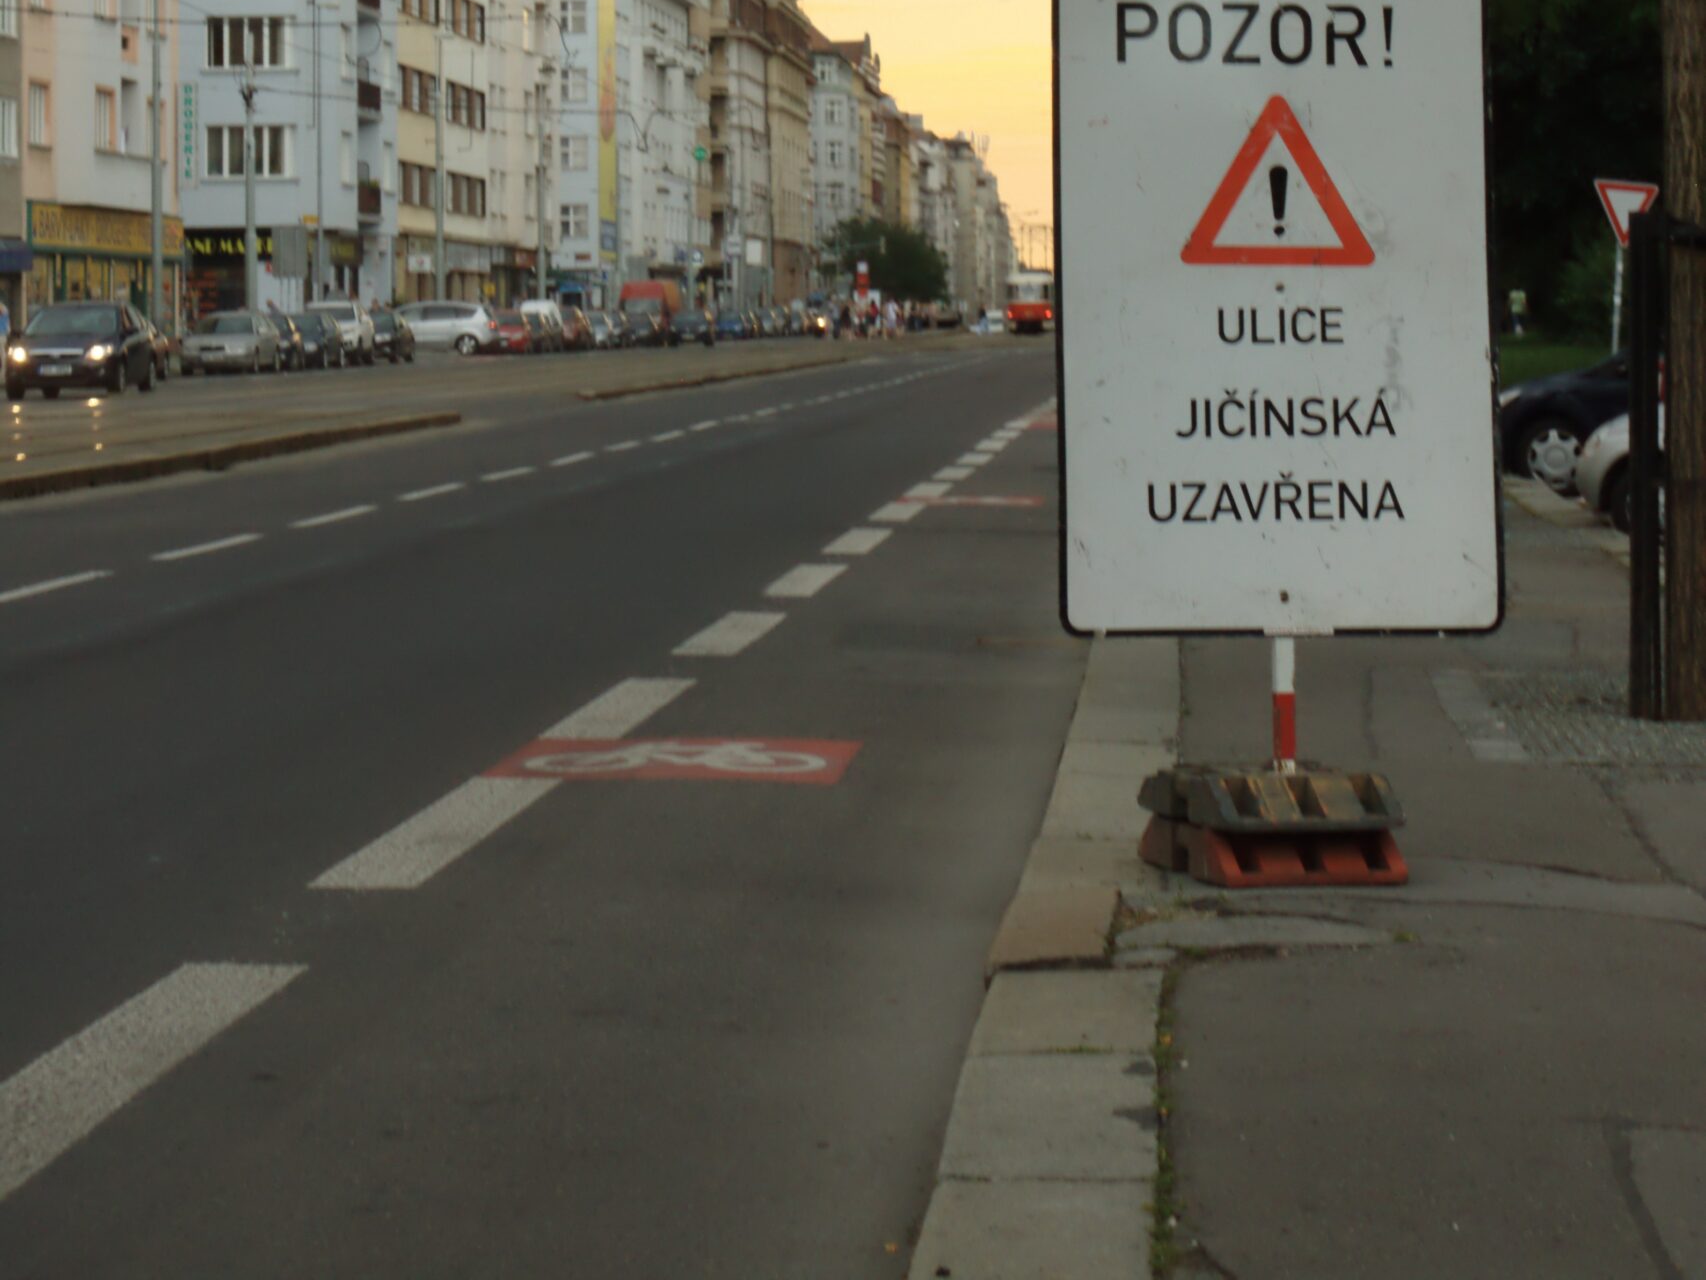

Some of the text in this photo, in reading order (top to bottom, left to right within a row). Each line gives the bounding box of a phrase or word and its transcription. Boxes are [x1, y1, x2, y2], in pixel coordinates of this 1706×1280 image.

[1116, 1, 1394, 67] POZOR!
[1217, 307, 1345, 345] ULICE
[1175, 387, 1397, 439] JIČÍNSKÁ
[1146, 472, 1406, 523] UZAVŘENA
